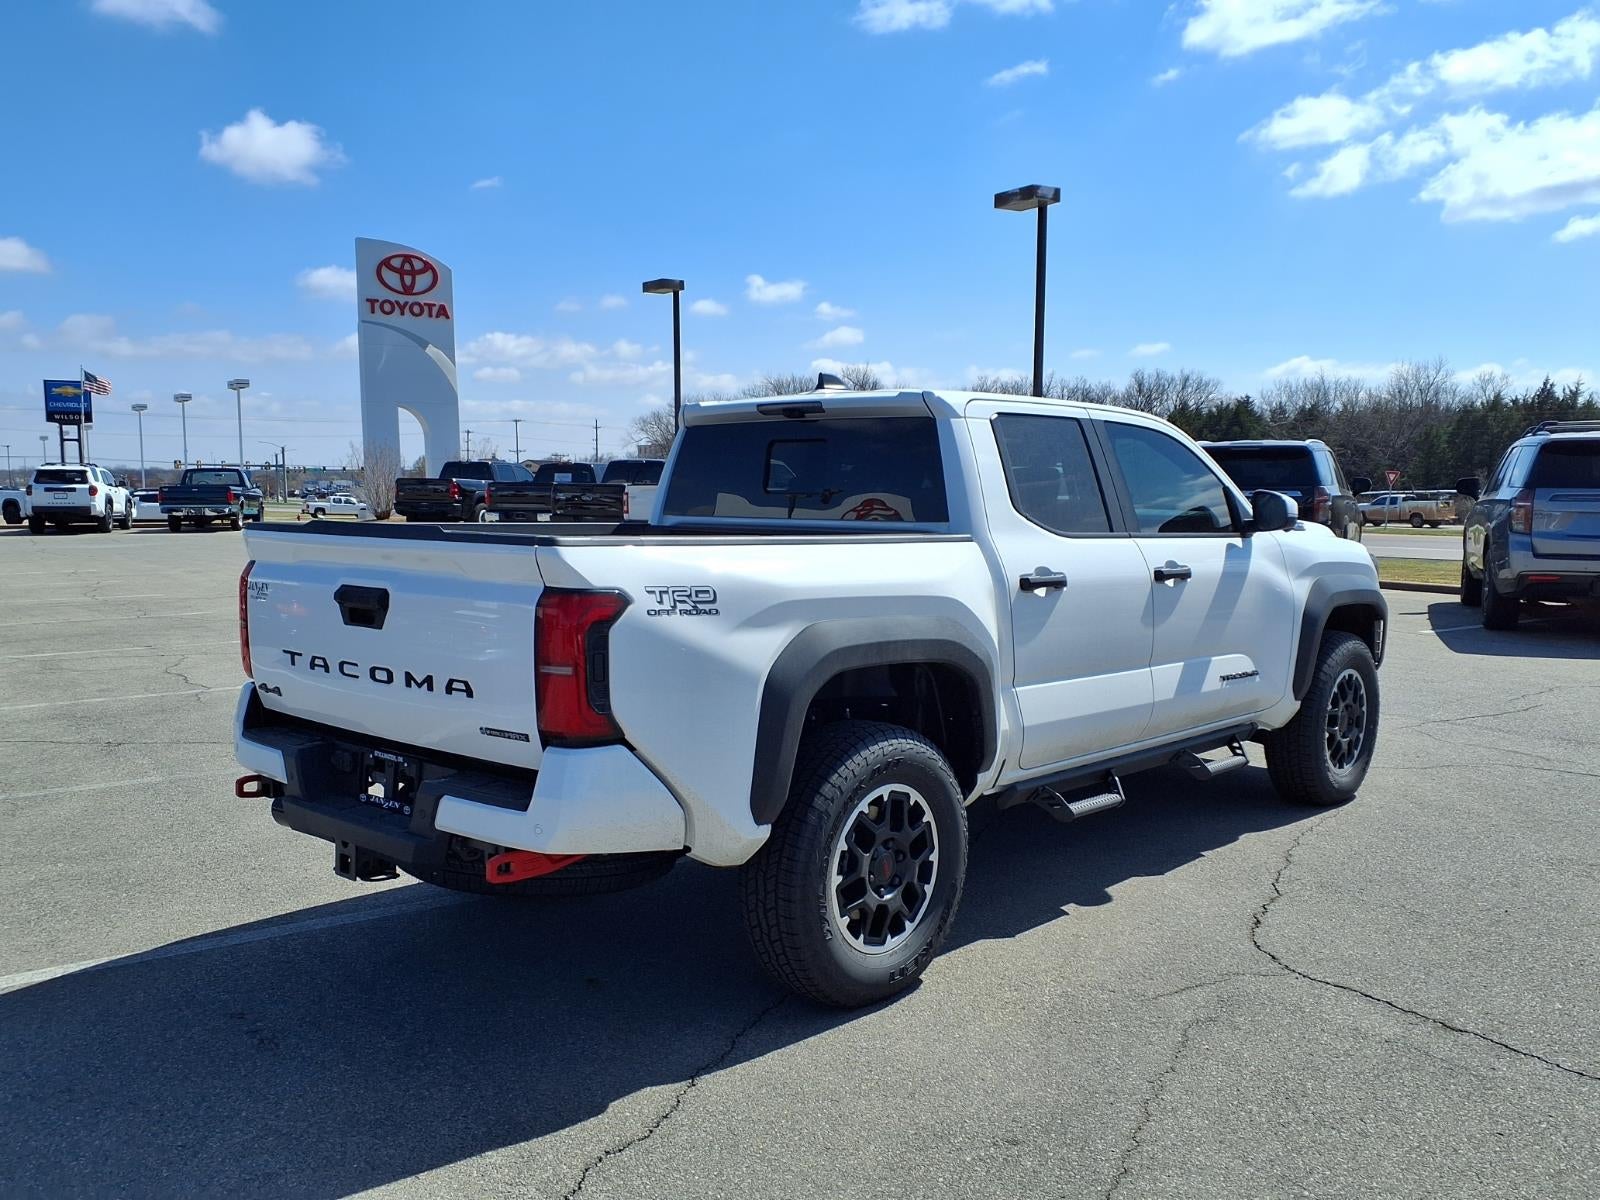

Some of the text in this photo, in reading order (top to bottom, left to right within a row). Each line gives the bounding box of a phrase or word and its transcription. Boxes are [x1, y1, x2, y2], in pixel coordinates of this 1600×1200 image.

[366, 298, 450, 320] TOYOTA
[644, 585, 718, 609] TRD
[679, 608, 720, 617] ROAD
[282, 649, 475, 700] TACOMA
[369, 795, 401, 809] JANZEN
